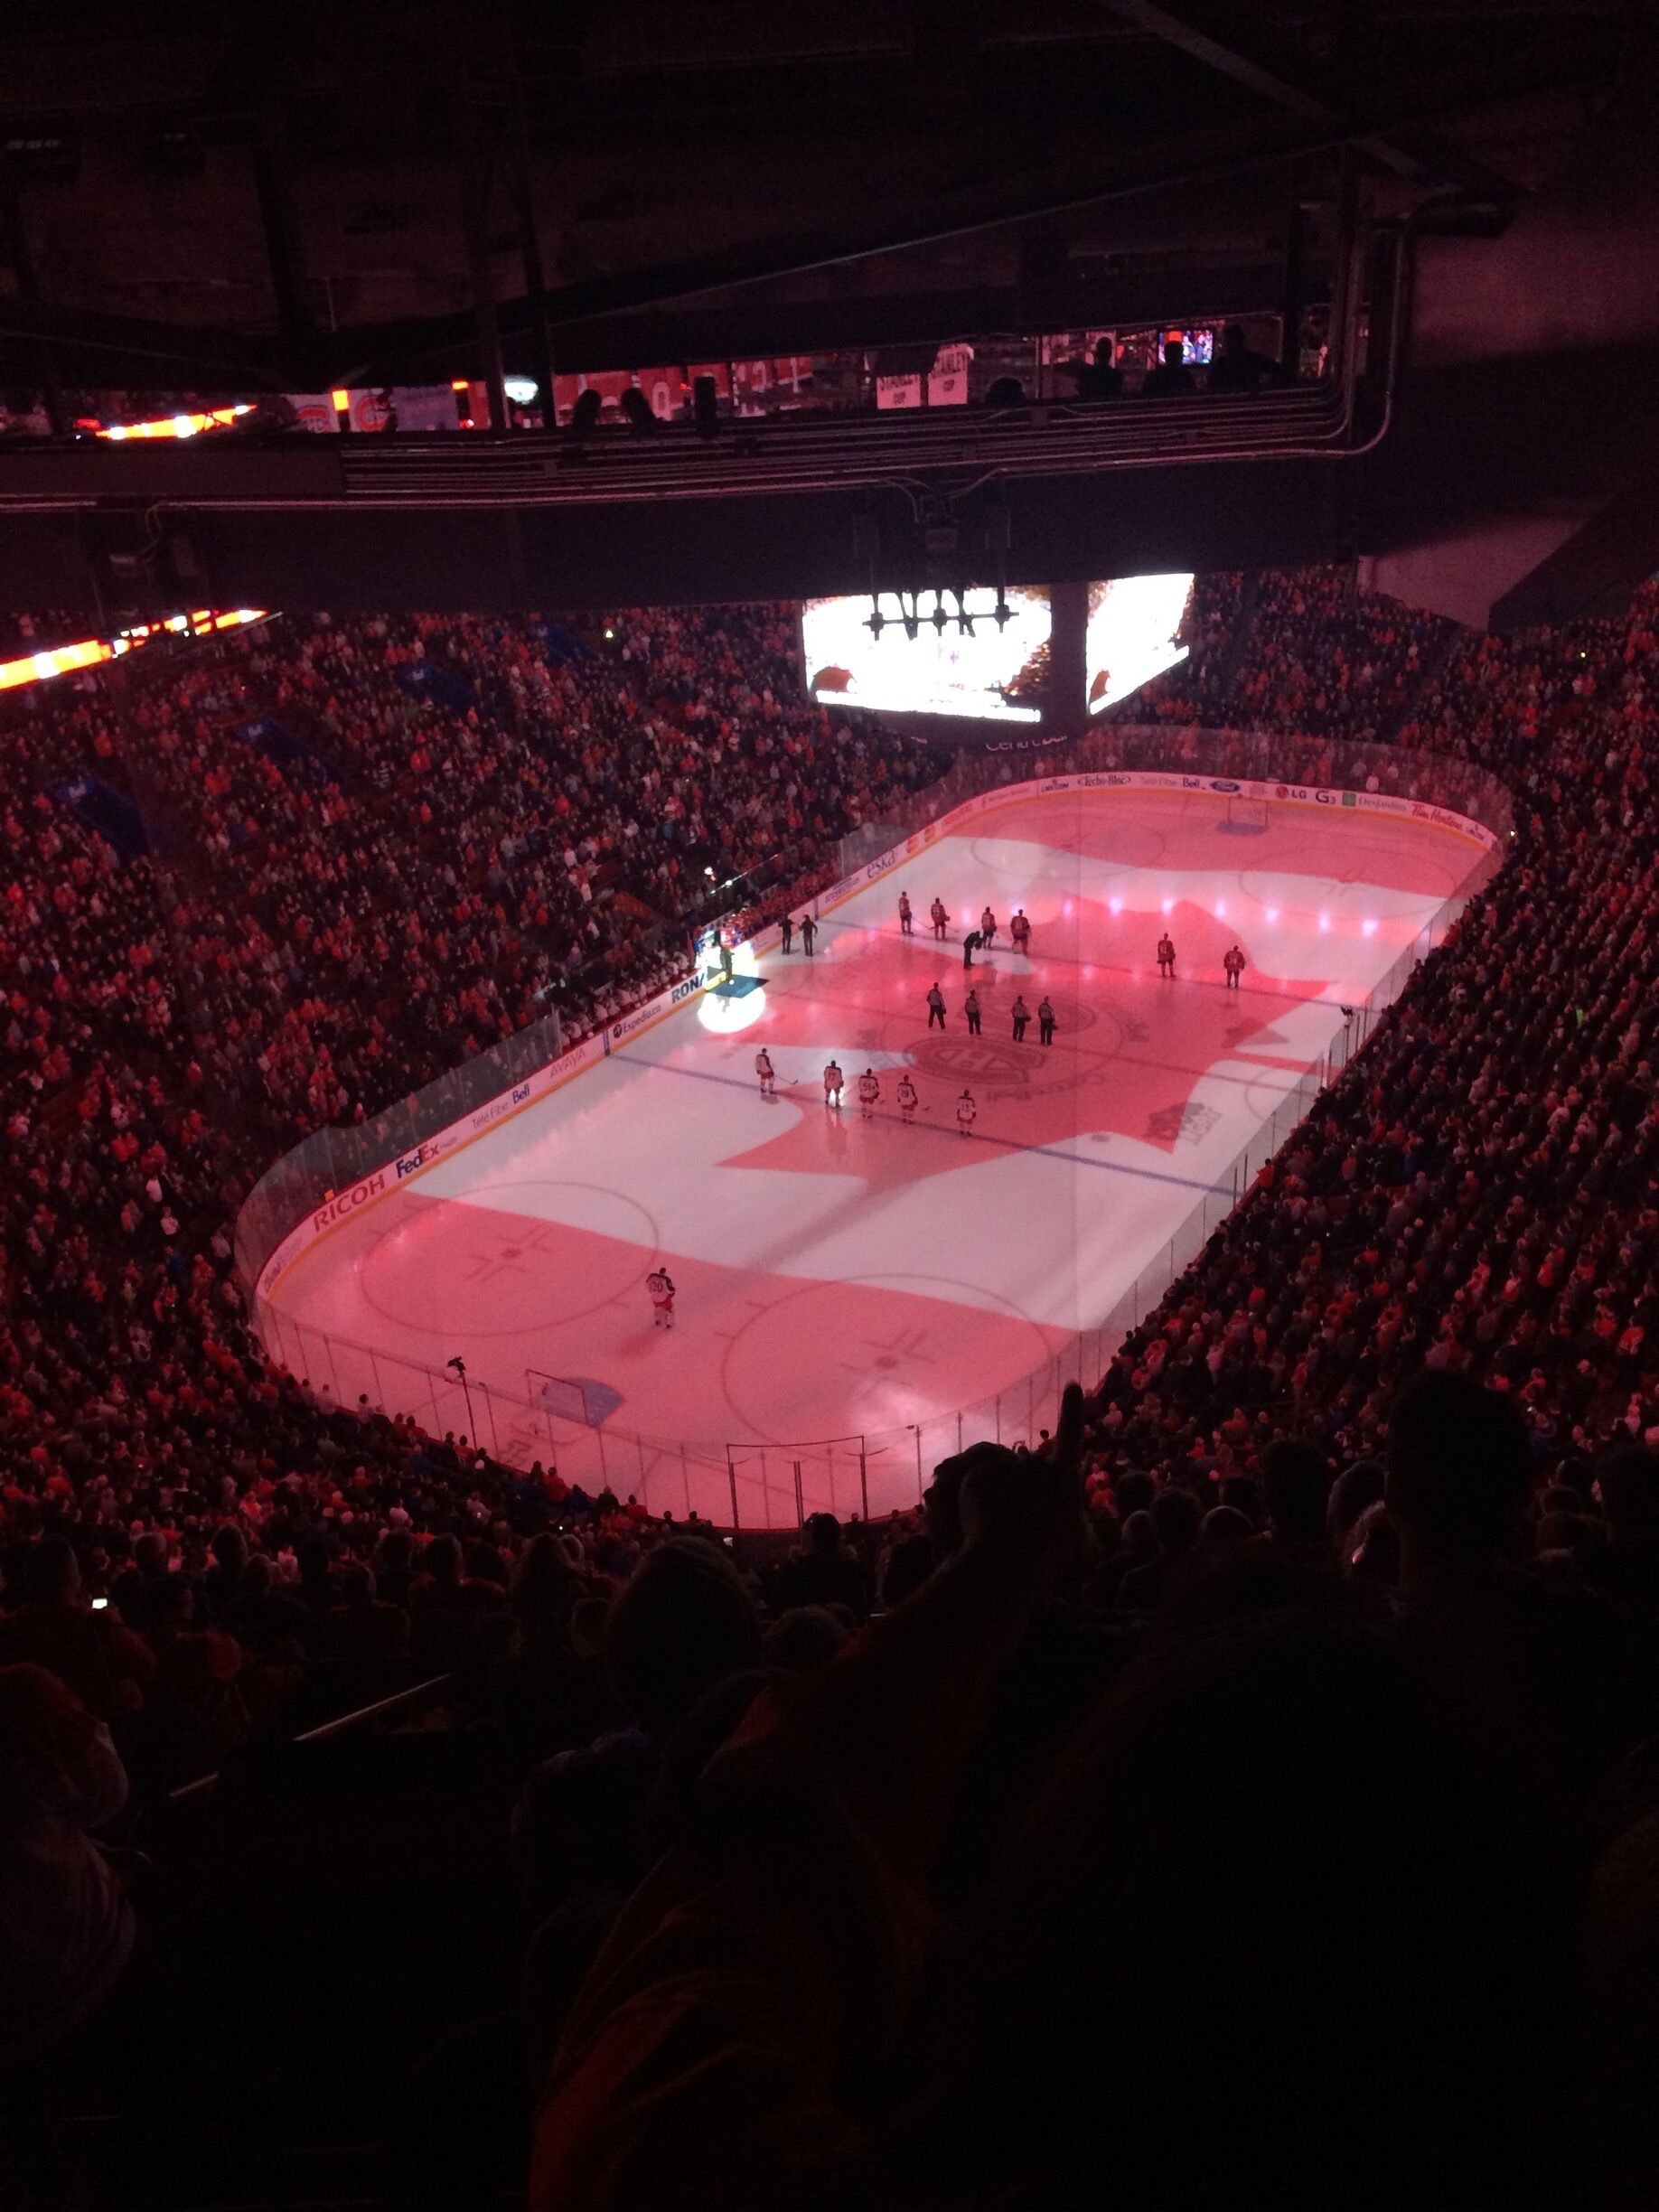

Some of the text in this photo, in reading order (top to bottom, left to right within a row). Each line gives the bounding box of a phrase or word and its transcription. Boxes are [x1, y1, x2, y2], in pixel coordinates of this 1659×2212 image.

[1182, 777, 1200, 789] Bell
[1291, 789, 1308, 800] LG
[512, 1083, 530, 1105] Bell
[396, 1144, 439, 1179] FedEx
[314, 1174, 385, 1232] RICOH
